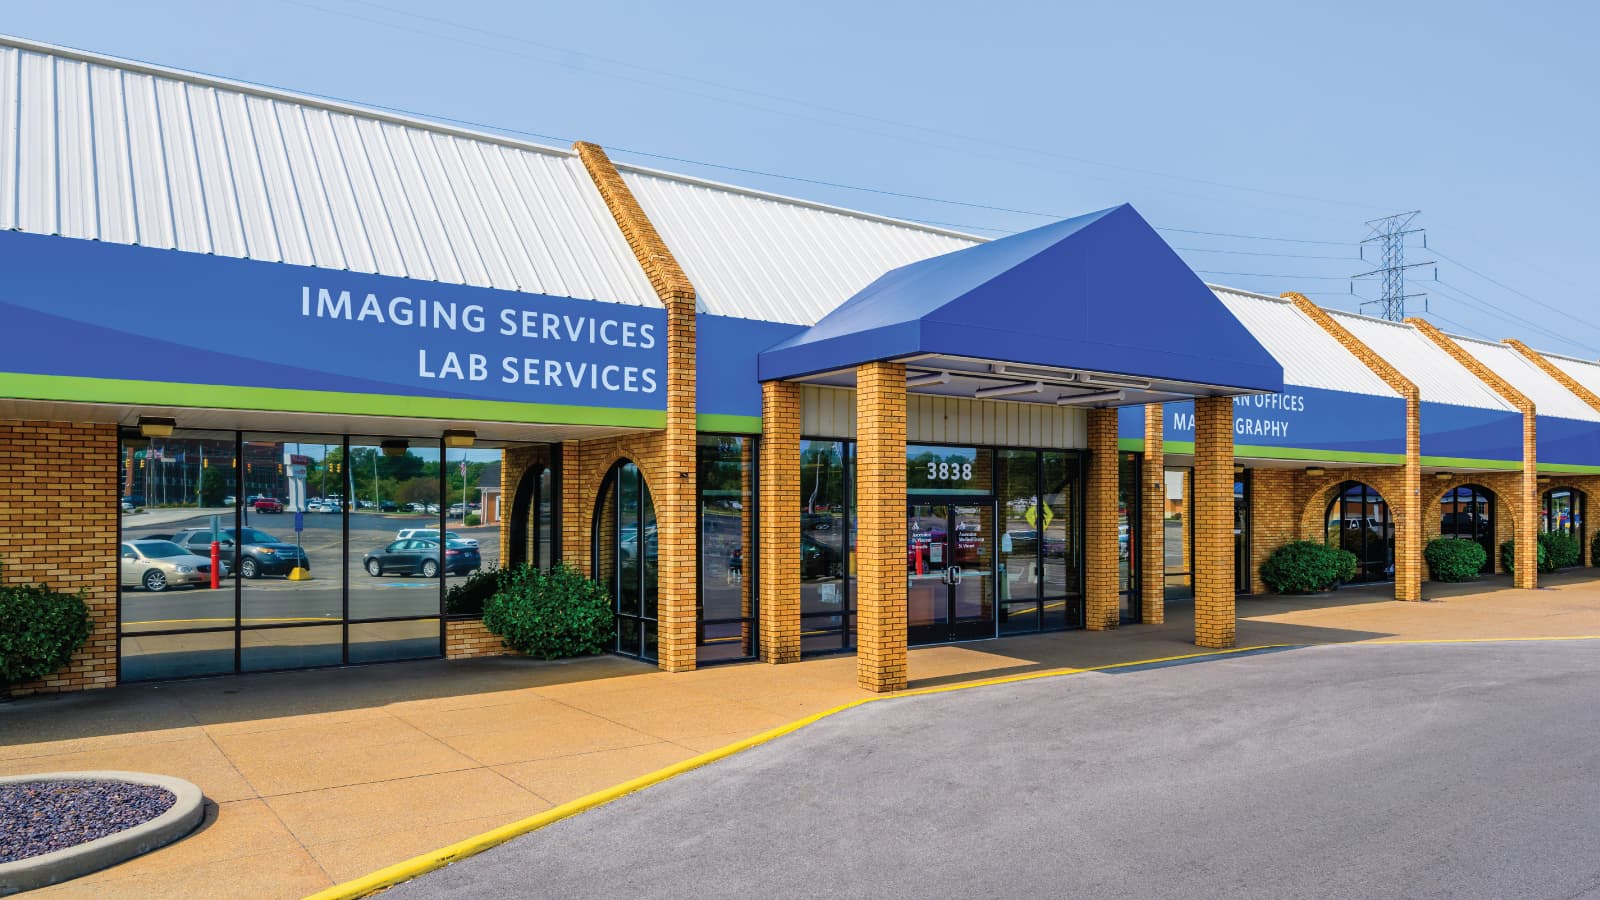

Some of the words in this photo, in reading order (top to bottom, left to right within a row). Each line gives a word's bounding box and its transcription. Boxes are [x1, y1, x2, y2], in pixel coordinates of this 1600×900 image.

[301, 286, 486, 333] IMAGING
[500, 308, 656, 349] SERVICES
[418, 349, 488, 382] LAB
[501, 356, 657, 393] SERVICES
[1254, 393, 1305, 412] OFFICES
[927, 462, 972, 480] 3838
